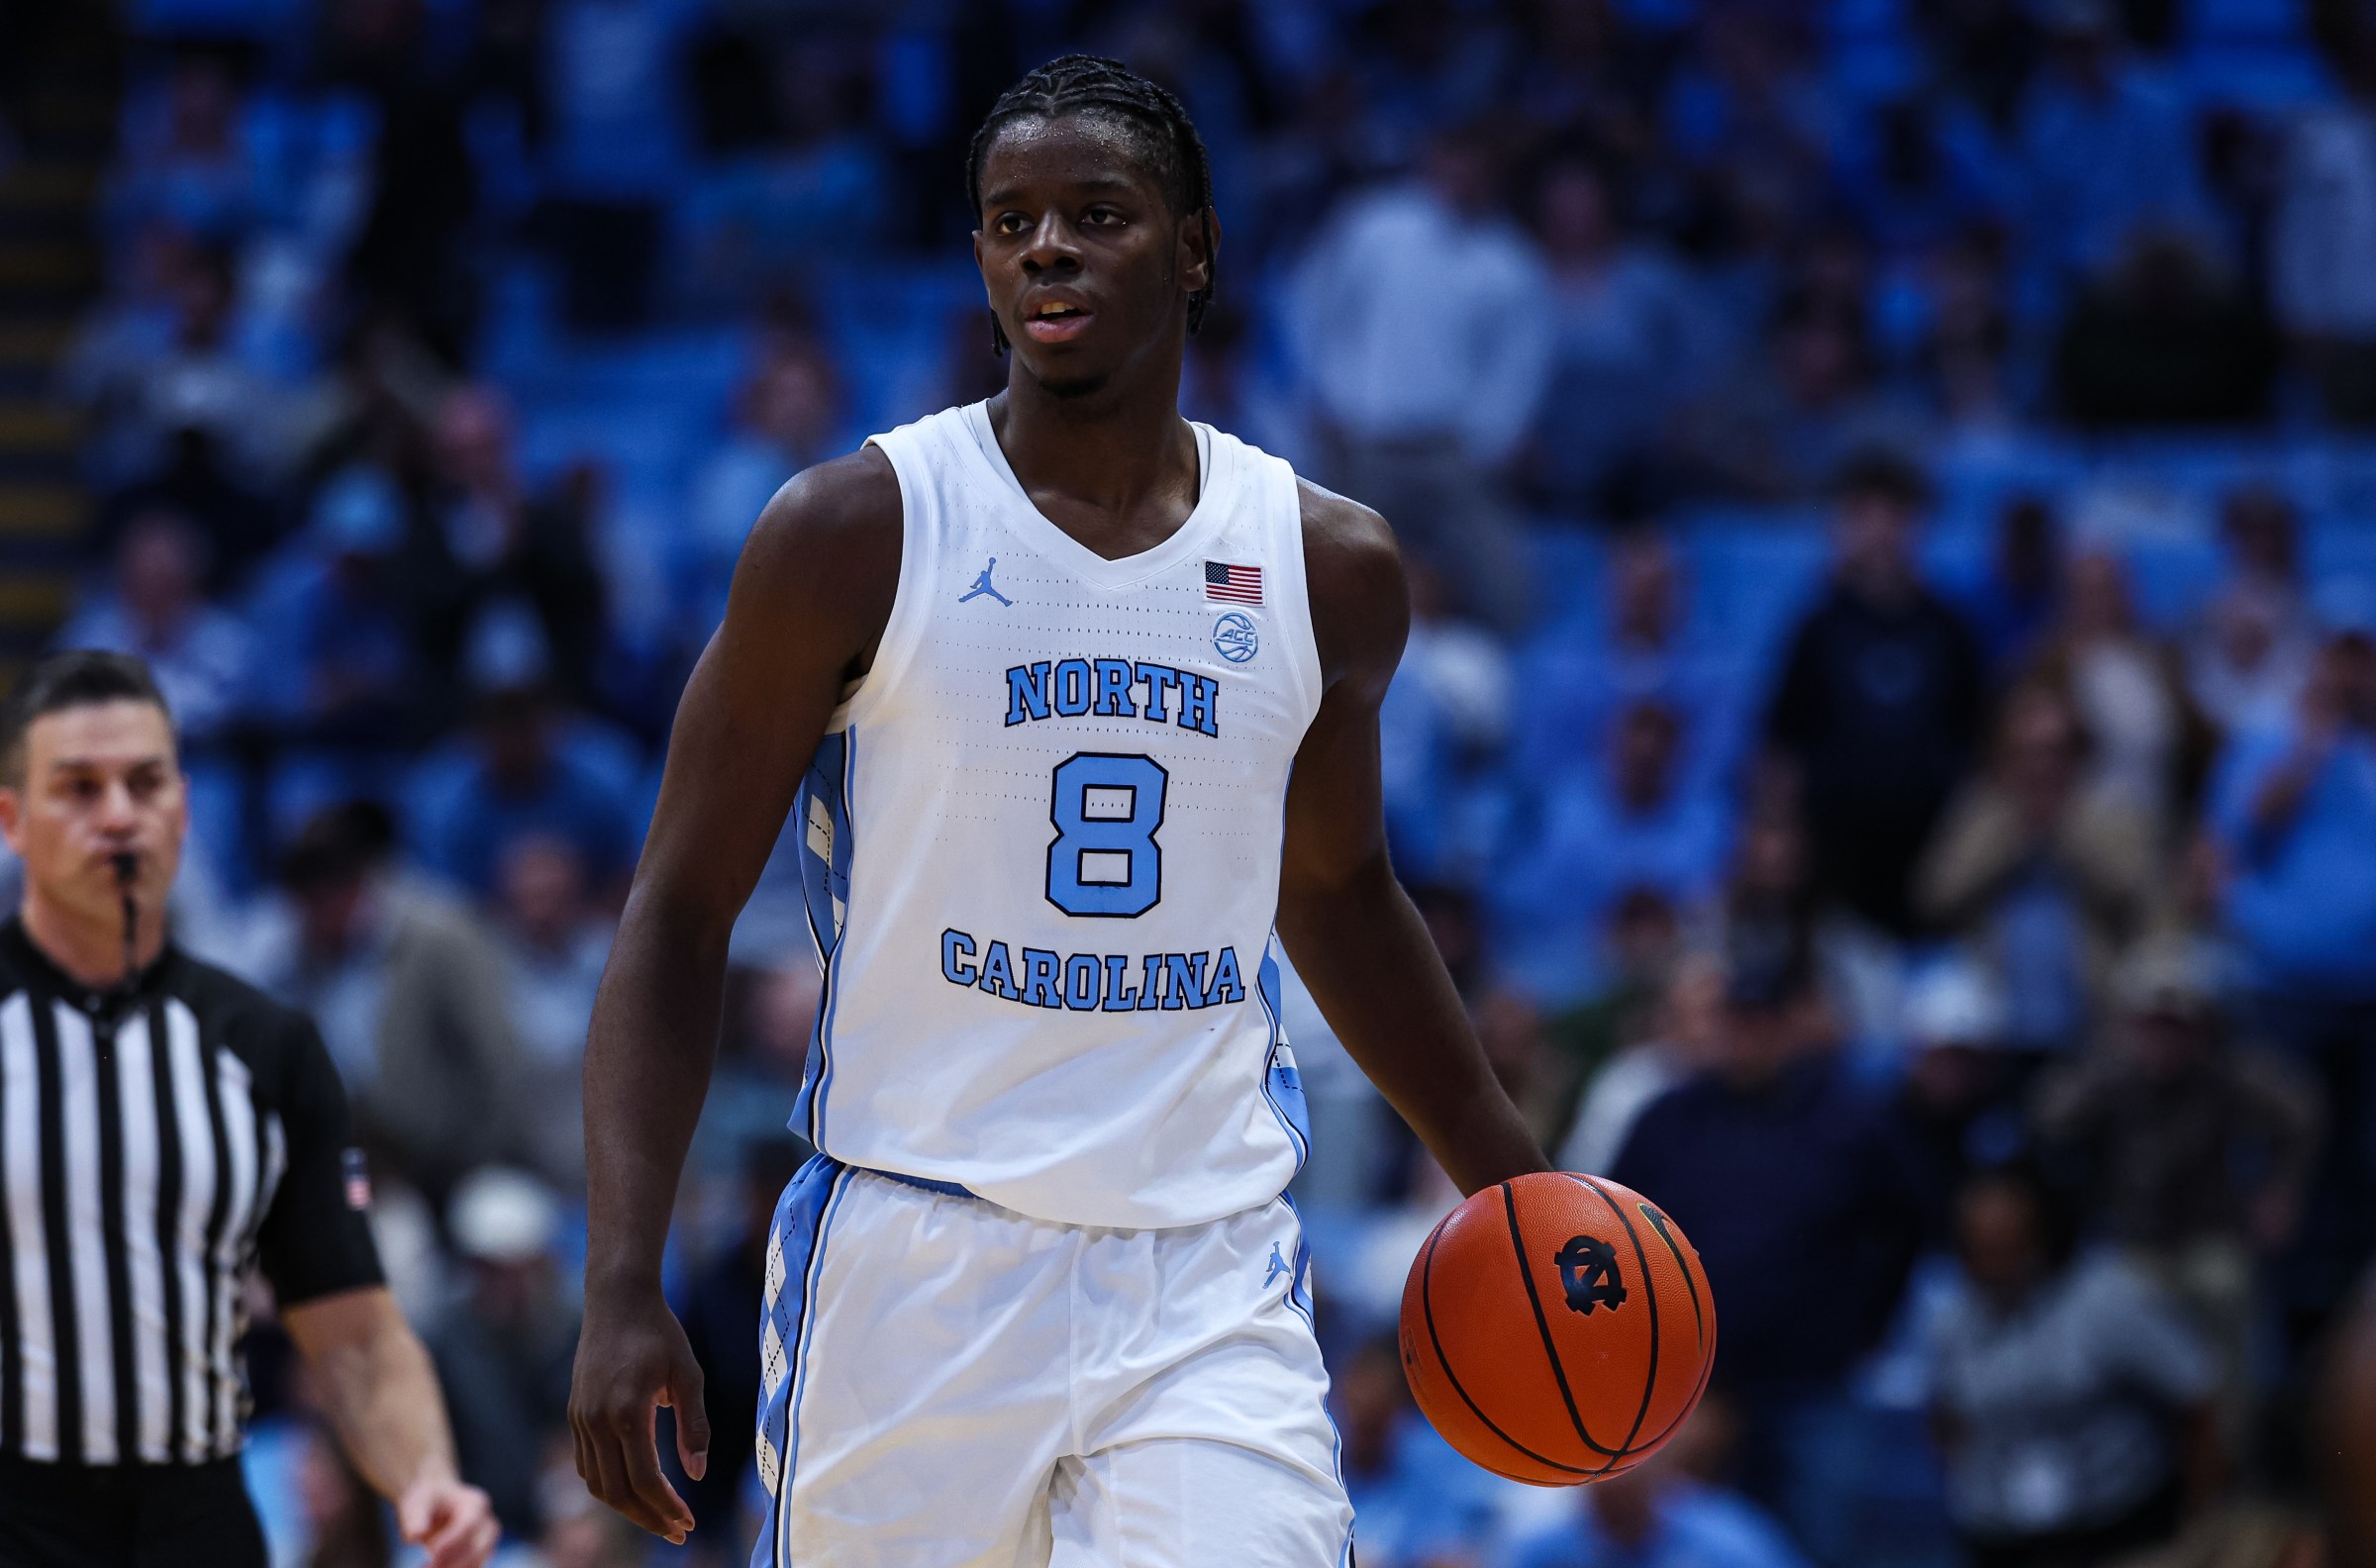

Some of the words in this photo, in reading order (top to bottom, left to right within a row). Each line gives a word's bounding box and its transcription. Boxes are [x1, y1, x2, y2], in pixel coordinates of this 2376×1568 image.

[1218, 628, 1256, 644] ACC
[1005, 658, 1219, 738] NORTH
[1045, 751, 1169, 919] 8
[940, 928, 1245, 1013] CAROLINA
